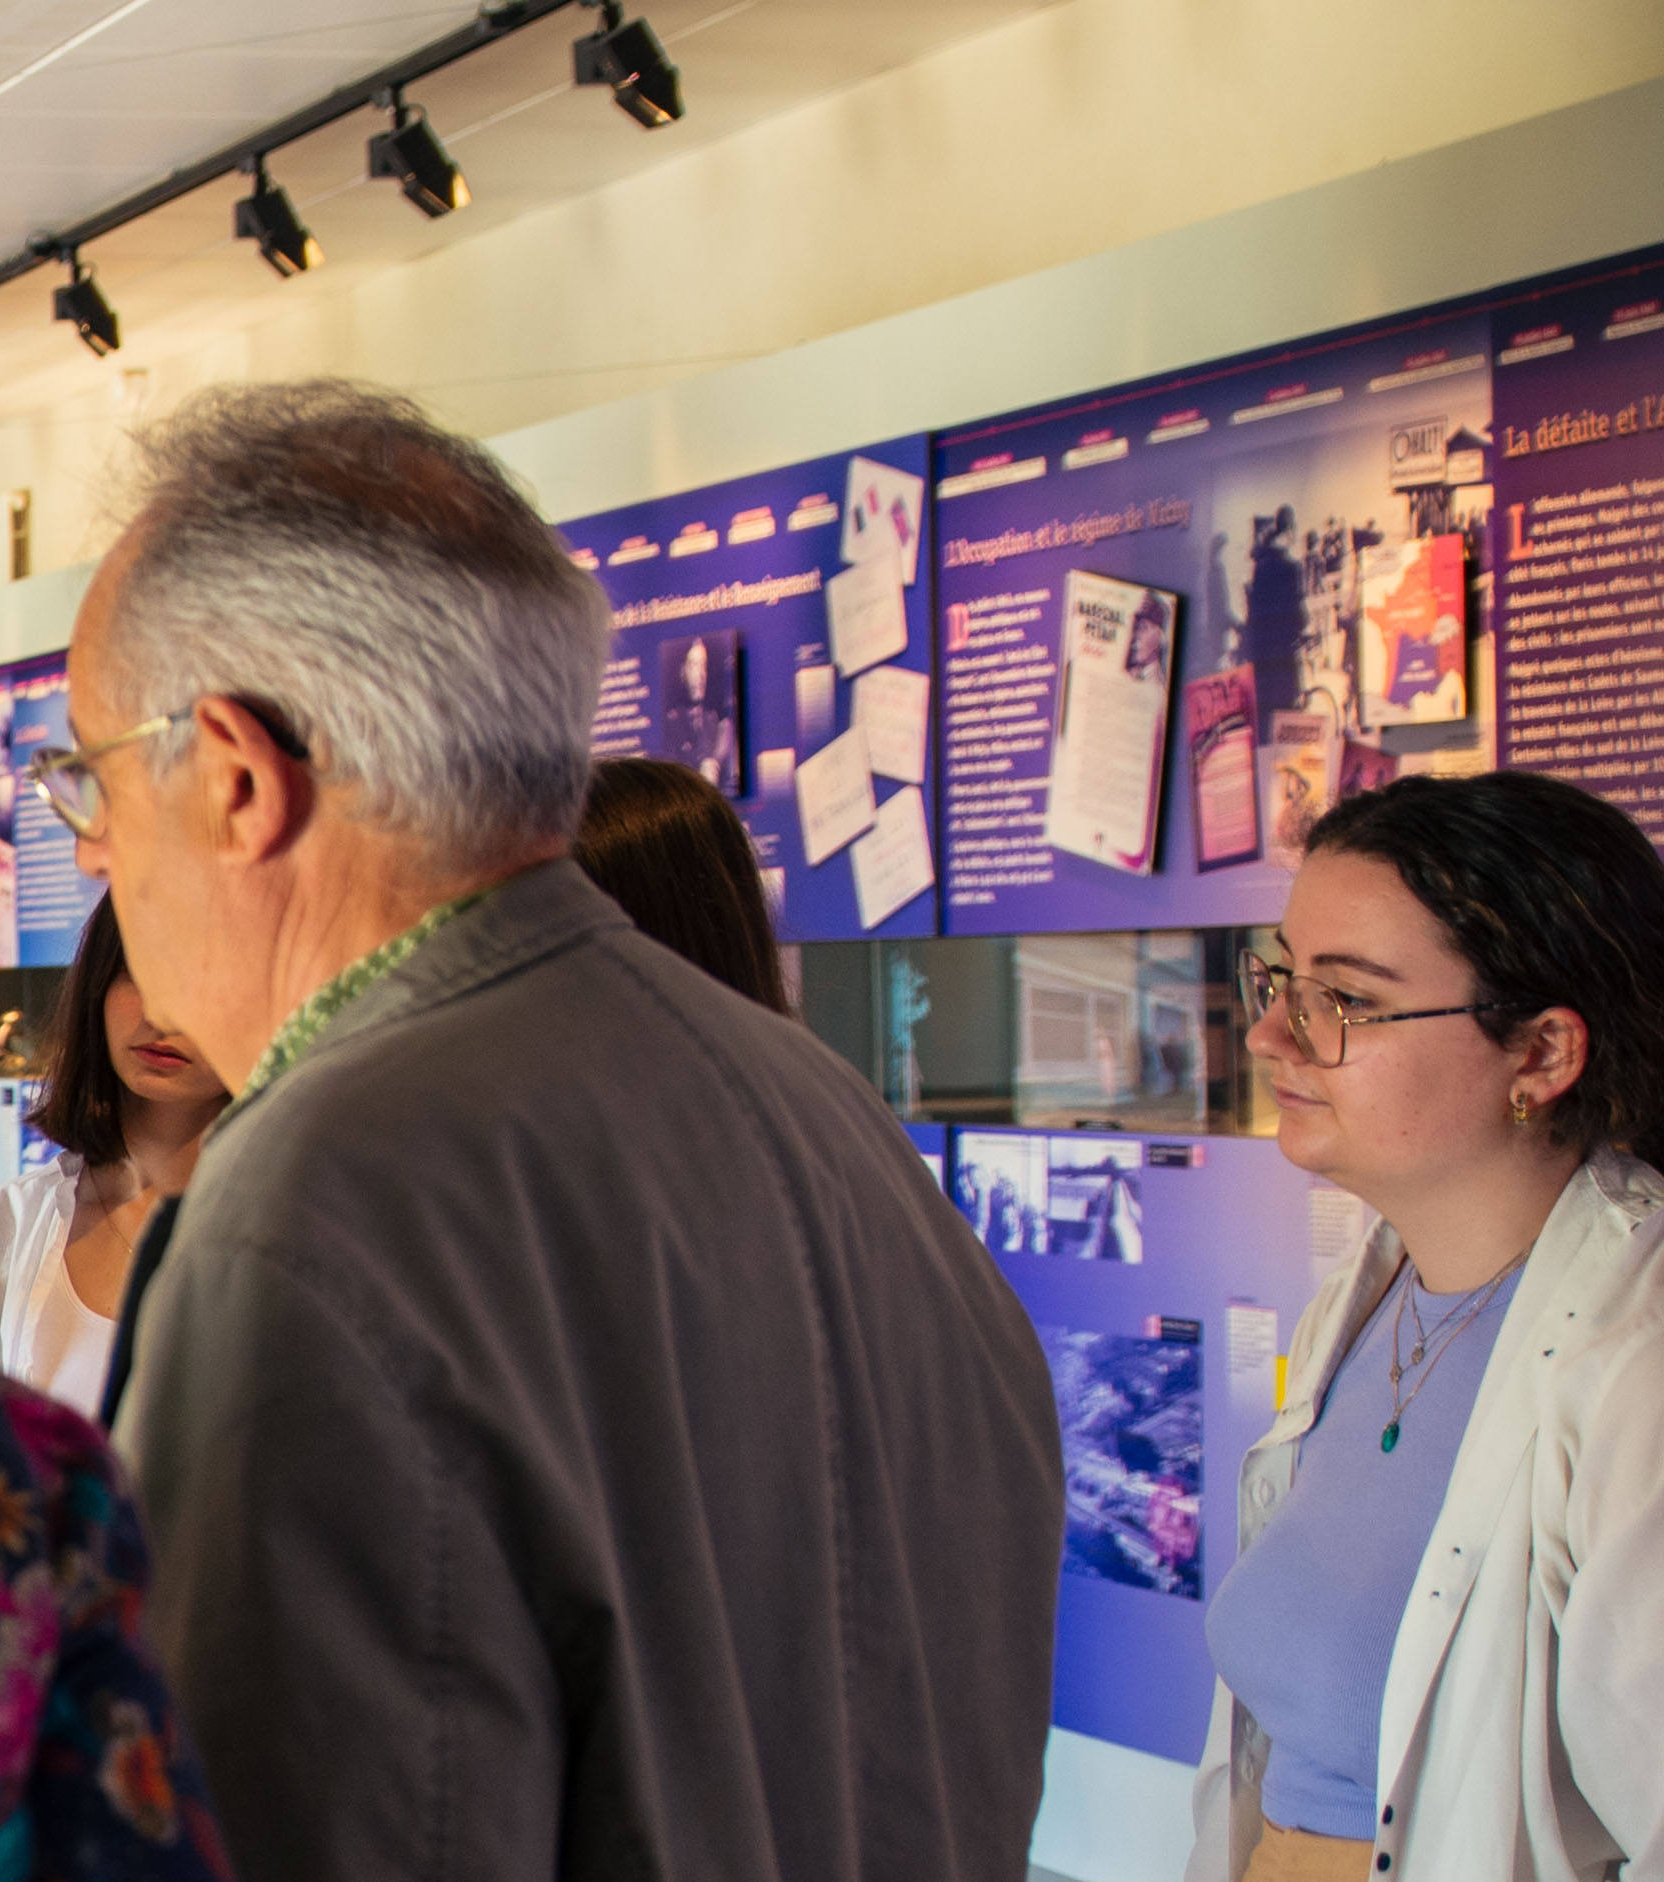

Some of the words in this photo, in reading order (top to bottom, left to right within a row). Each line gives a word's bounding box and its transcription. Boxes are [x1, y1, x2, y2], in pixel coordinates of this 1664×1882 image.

[1502, 426, 1530, 458] La
[1536, 409, 1610, 451] défaite
[1616, 402, 1639, 433] et
